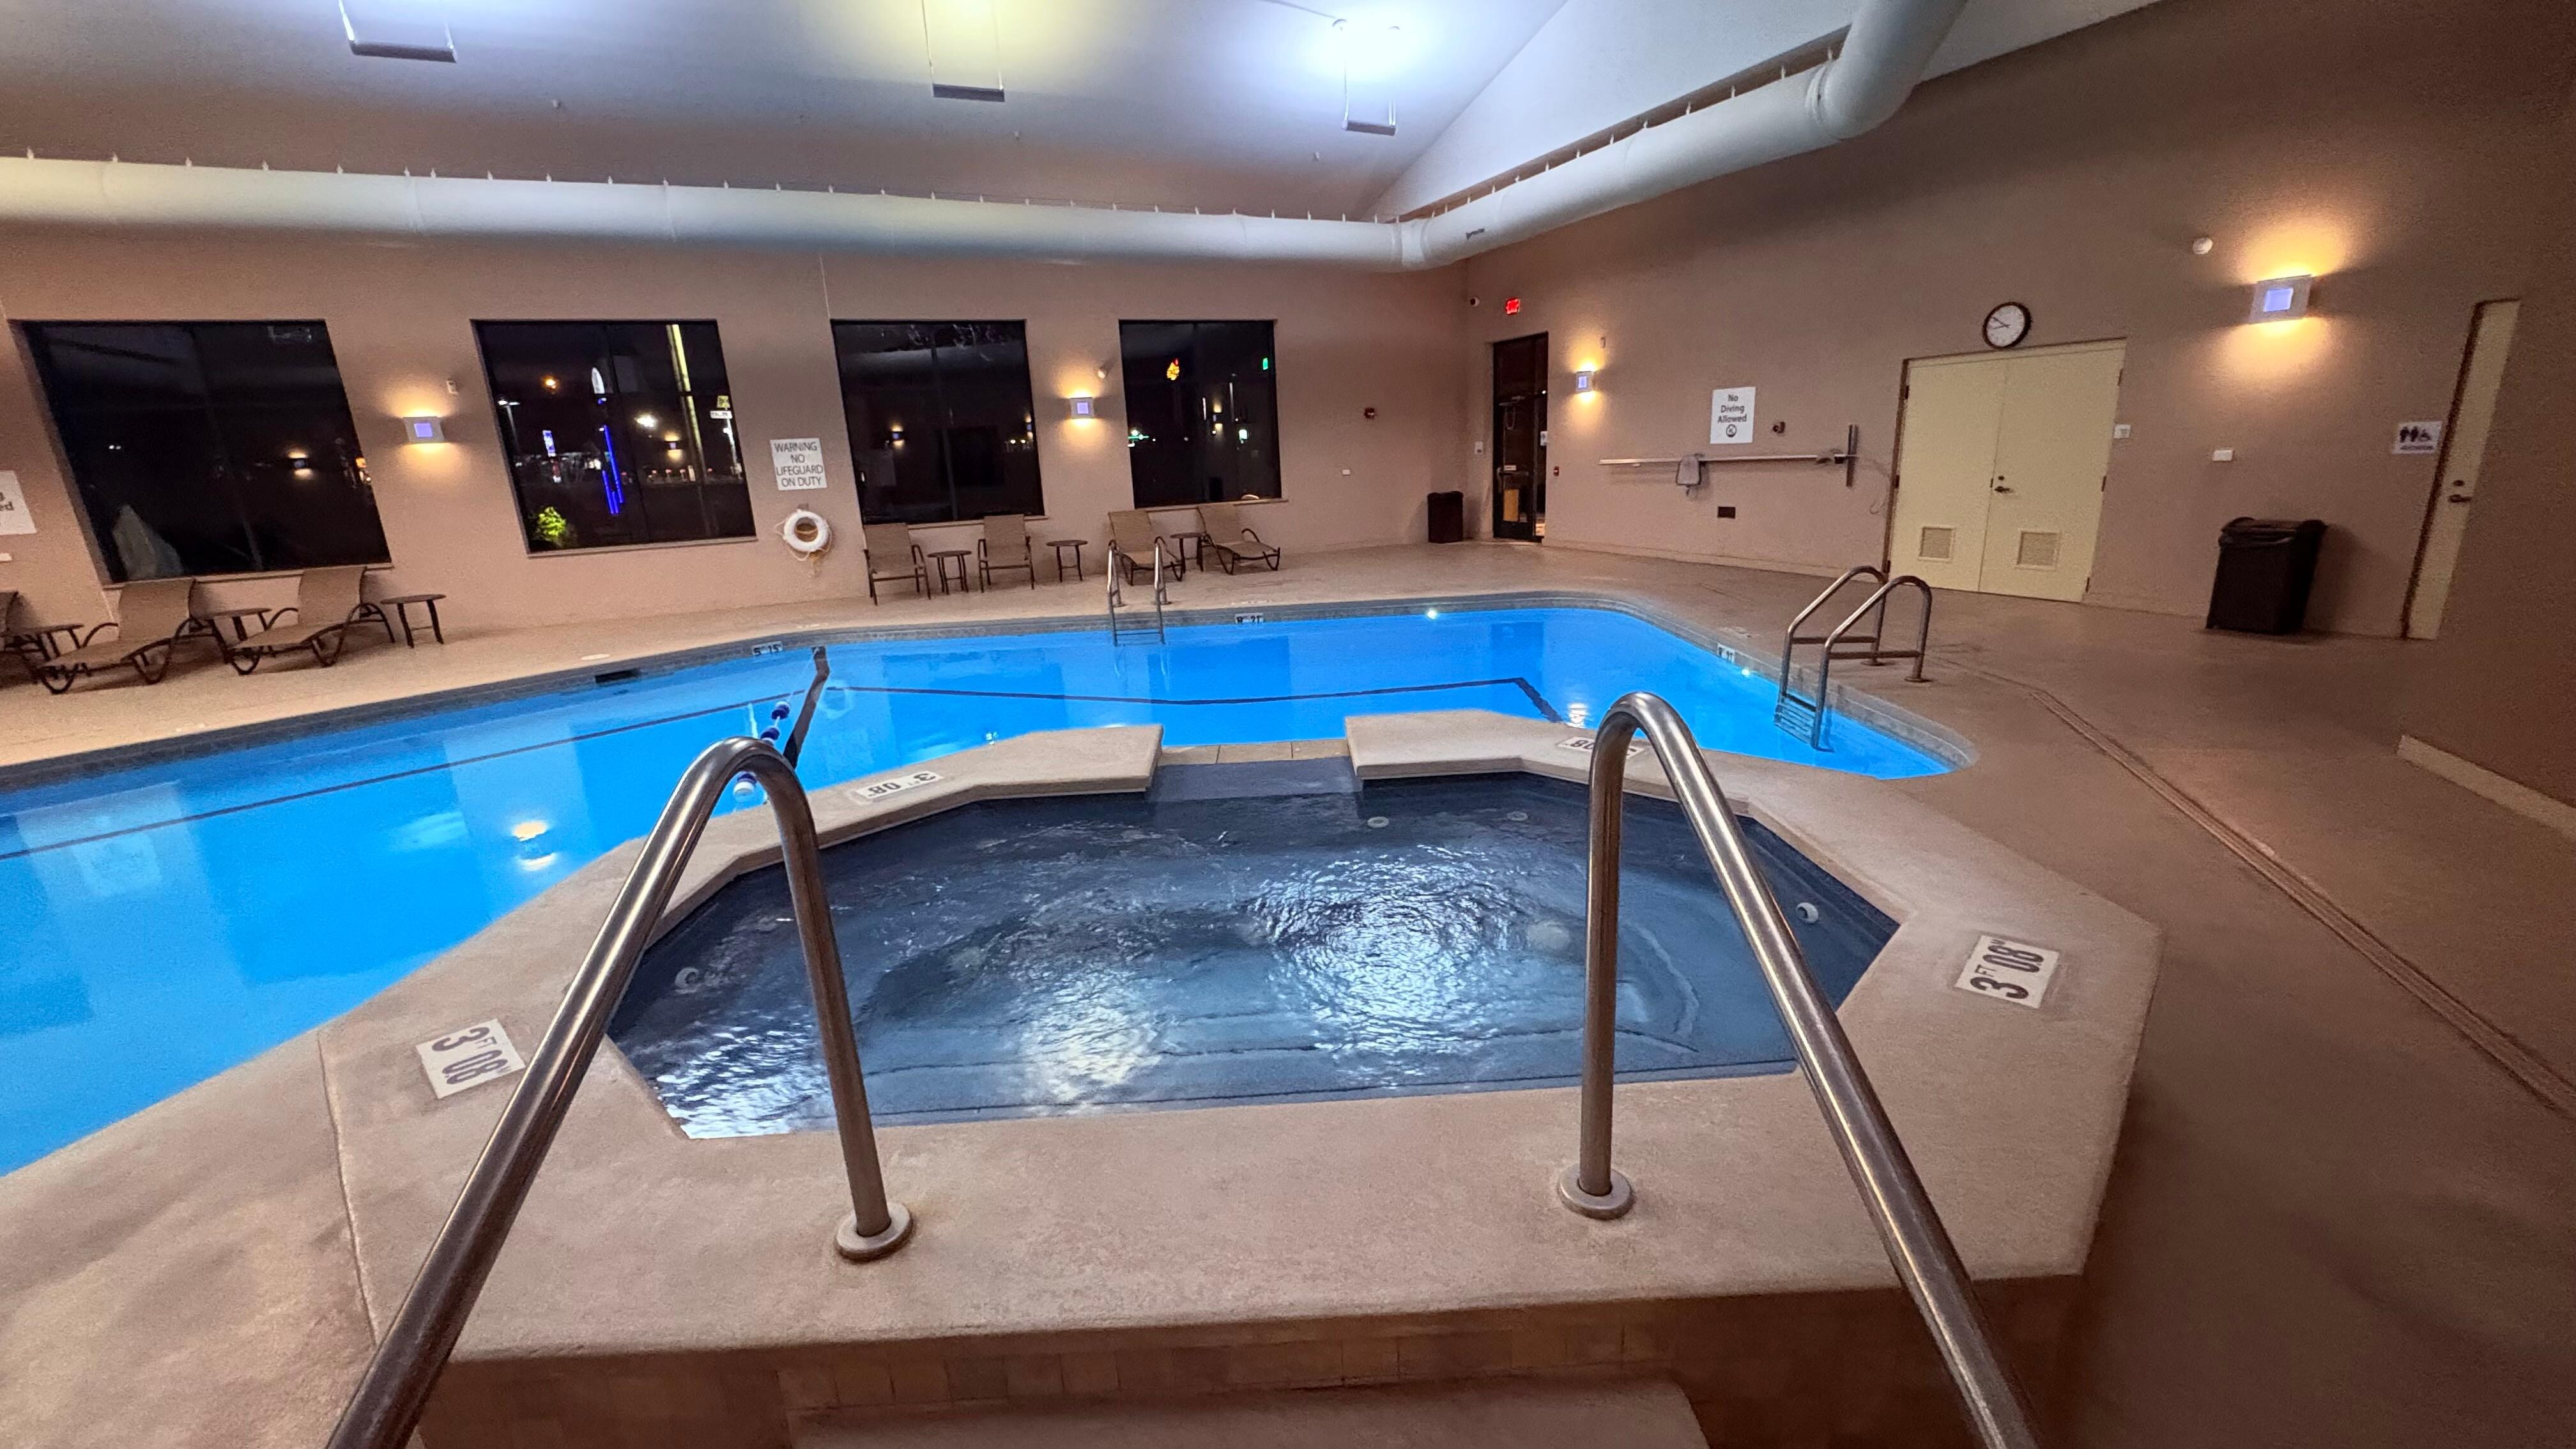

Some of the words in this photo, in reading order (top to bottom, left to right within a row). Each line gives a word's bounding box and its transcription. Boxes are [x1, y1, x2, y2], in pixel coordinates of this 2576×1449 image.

[1721, 404, 1745, 414] Diving
[1717, 413, 1747, 424] Allowed
[774, 441, 818, 453] WARNING
[790, 454, 806, 464] NO
[776, 464, 824, 476] LIFEGUARD
[781, 478, 796, 487] ON
[797, 477, 822, 487] DUTY
[1970, 976, 2029, 999] 3
[431, 1027, 490, 1052] 3
